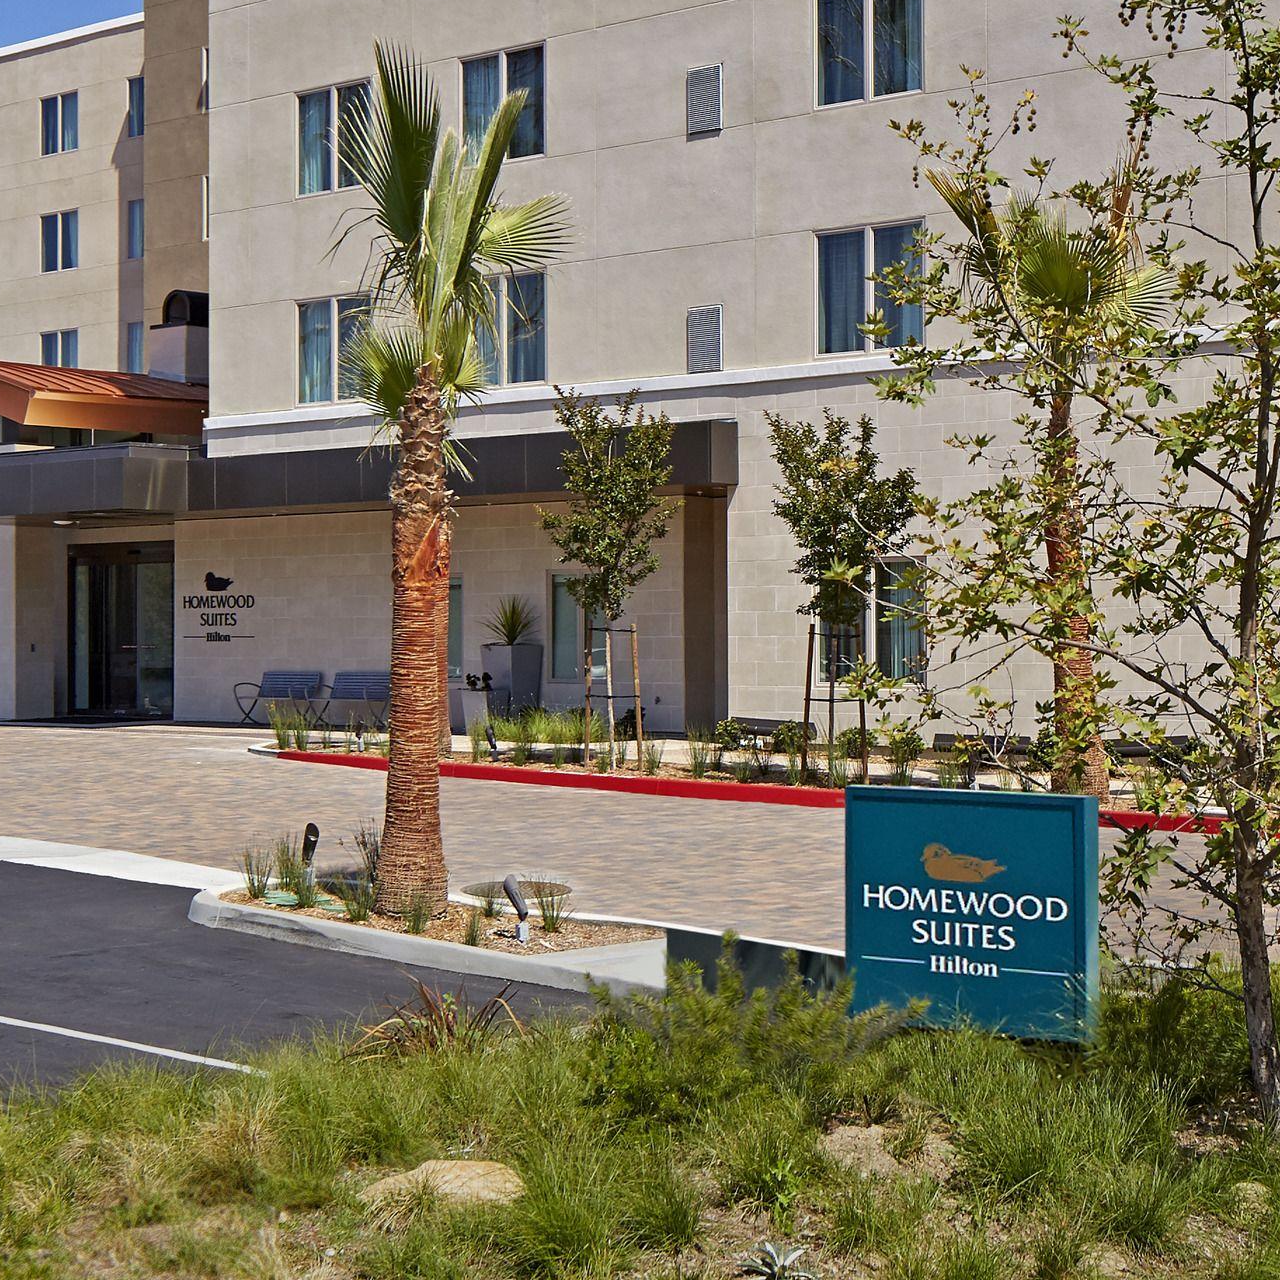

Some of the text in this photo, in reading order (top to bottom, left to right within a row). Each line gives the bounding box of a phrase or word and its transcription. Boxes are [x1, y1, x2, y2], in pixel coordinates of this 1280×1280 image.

[183, 595, 255, 609] HOMEWOOD
[200, 613, 237, 627] SUITES
[863, 884, 1068, 922] HOMEWOOD
[911, 919, 1016, 950] SUITES
[930, 955, 999, 977] Hilton
